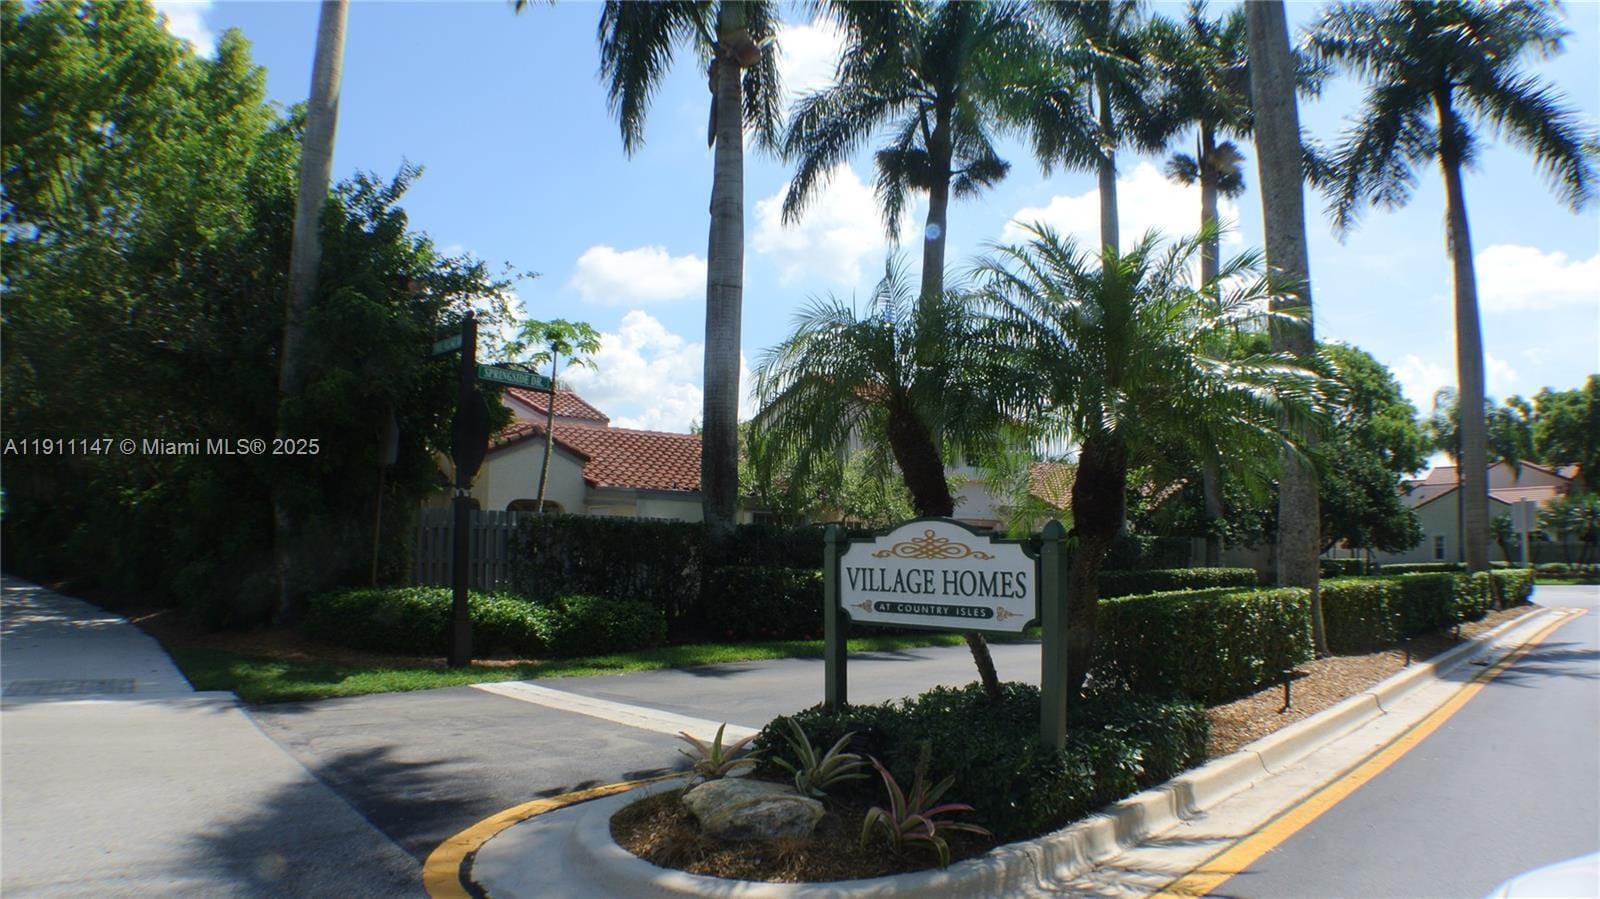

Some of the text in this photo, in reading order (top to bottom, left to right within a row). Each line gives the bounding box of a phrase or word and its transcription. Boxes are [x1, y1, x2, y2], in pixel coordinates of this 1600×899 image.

[484, 368, 529, 384] SPRINGSIDE
[846, 567, 1027, 599] VILLAGE HOMES
[879, 603, 986, 617] AT COUNTRY ISLES
